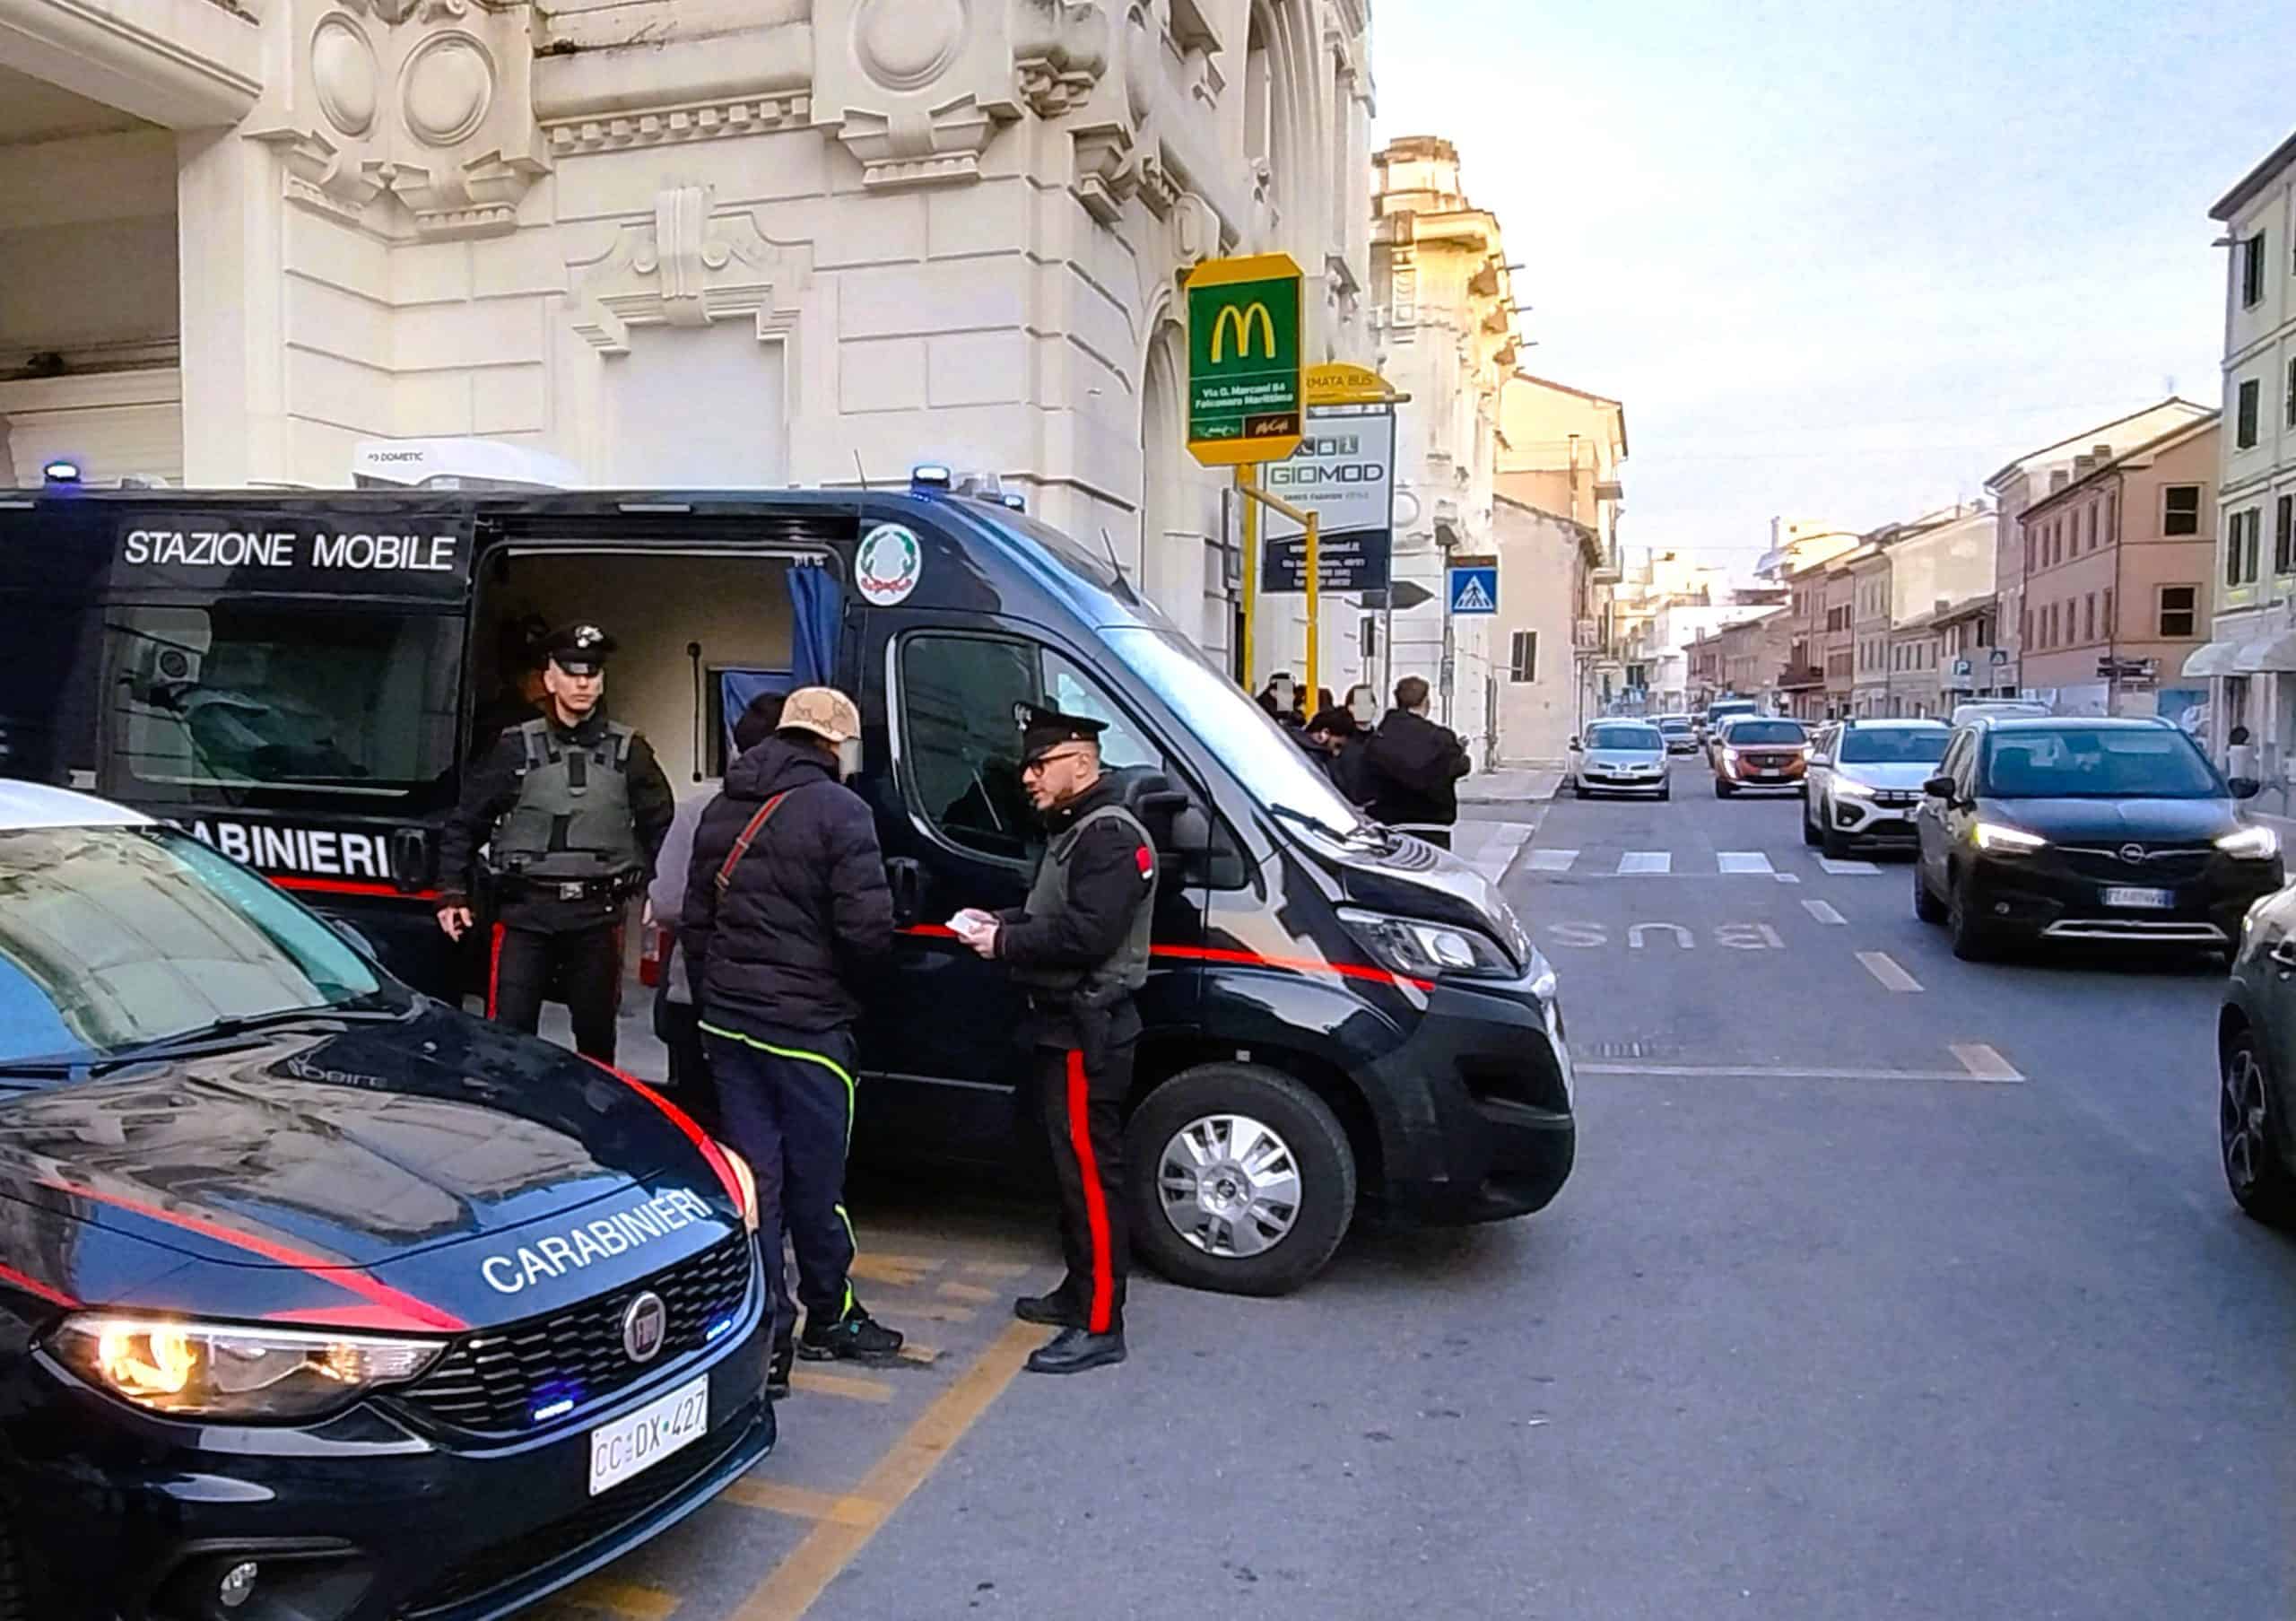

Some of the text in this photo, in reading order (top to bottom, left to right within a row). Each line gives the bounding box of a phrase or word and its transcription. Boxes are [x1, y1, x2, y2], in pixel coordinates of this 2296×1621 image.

[380, 452, 423, 461] DOMETIC
[1270, 464, 1385, 485] GIOMOD
[124, 530, 458, 571] STAZIONE MOBILE
[167, 817, 391, 878] ABINIERI
[482, 1188, 714, 1294] CARABINIERI
